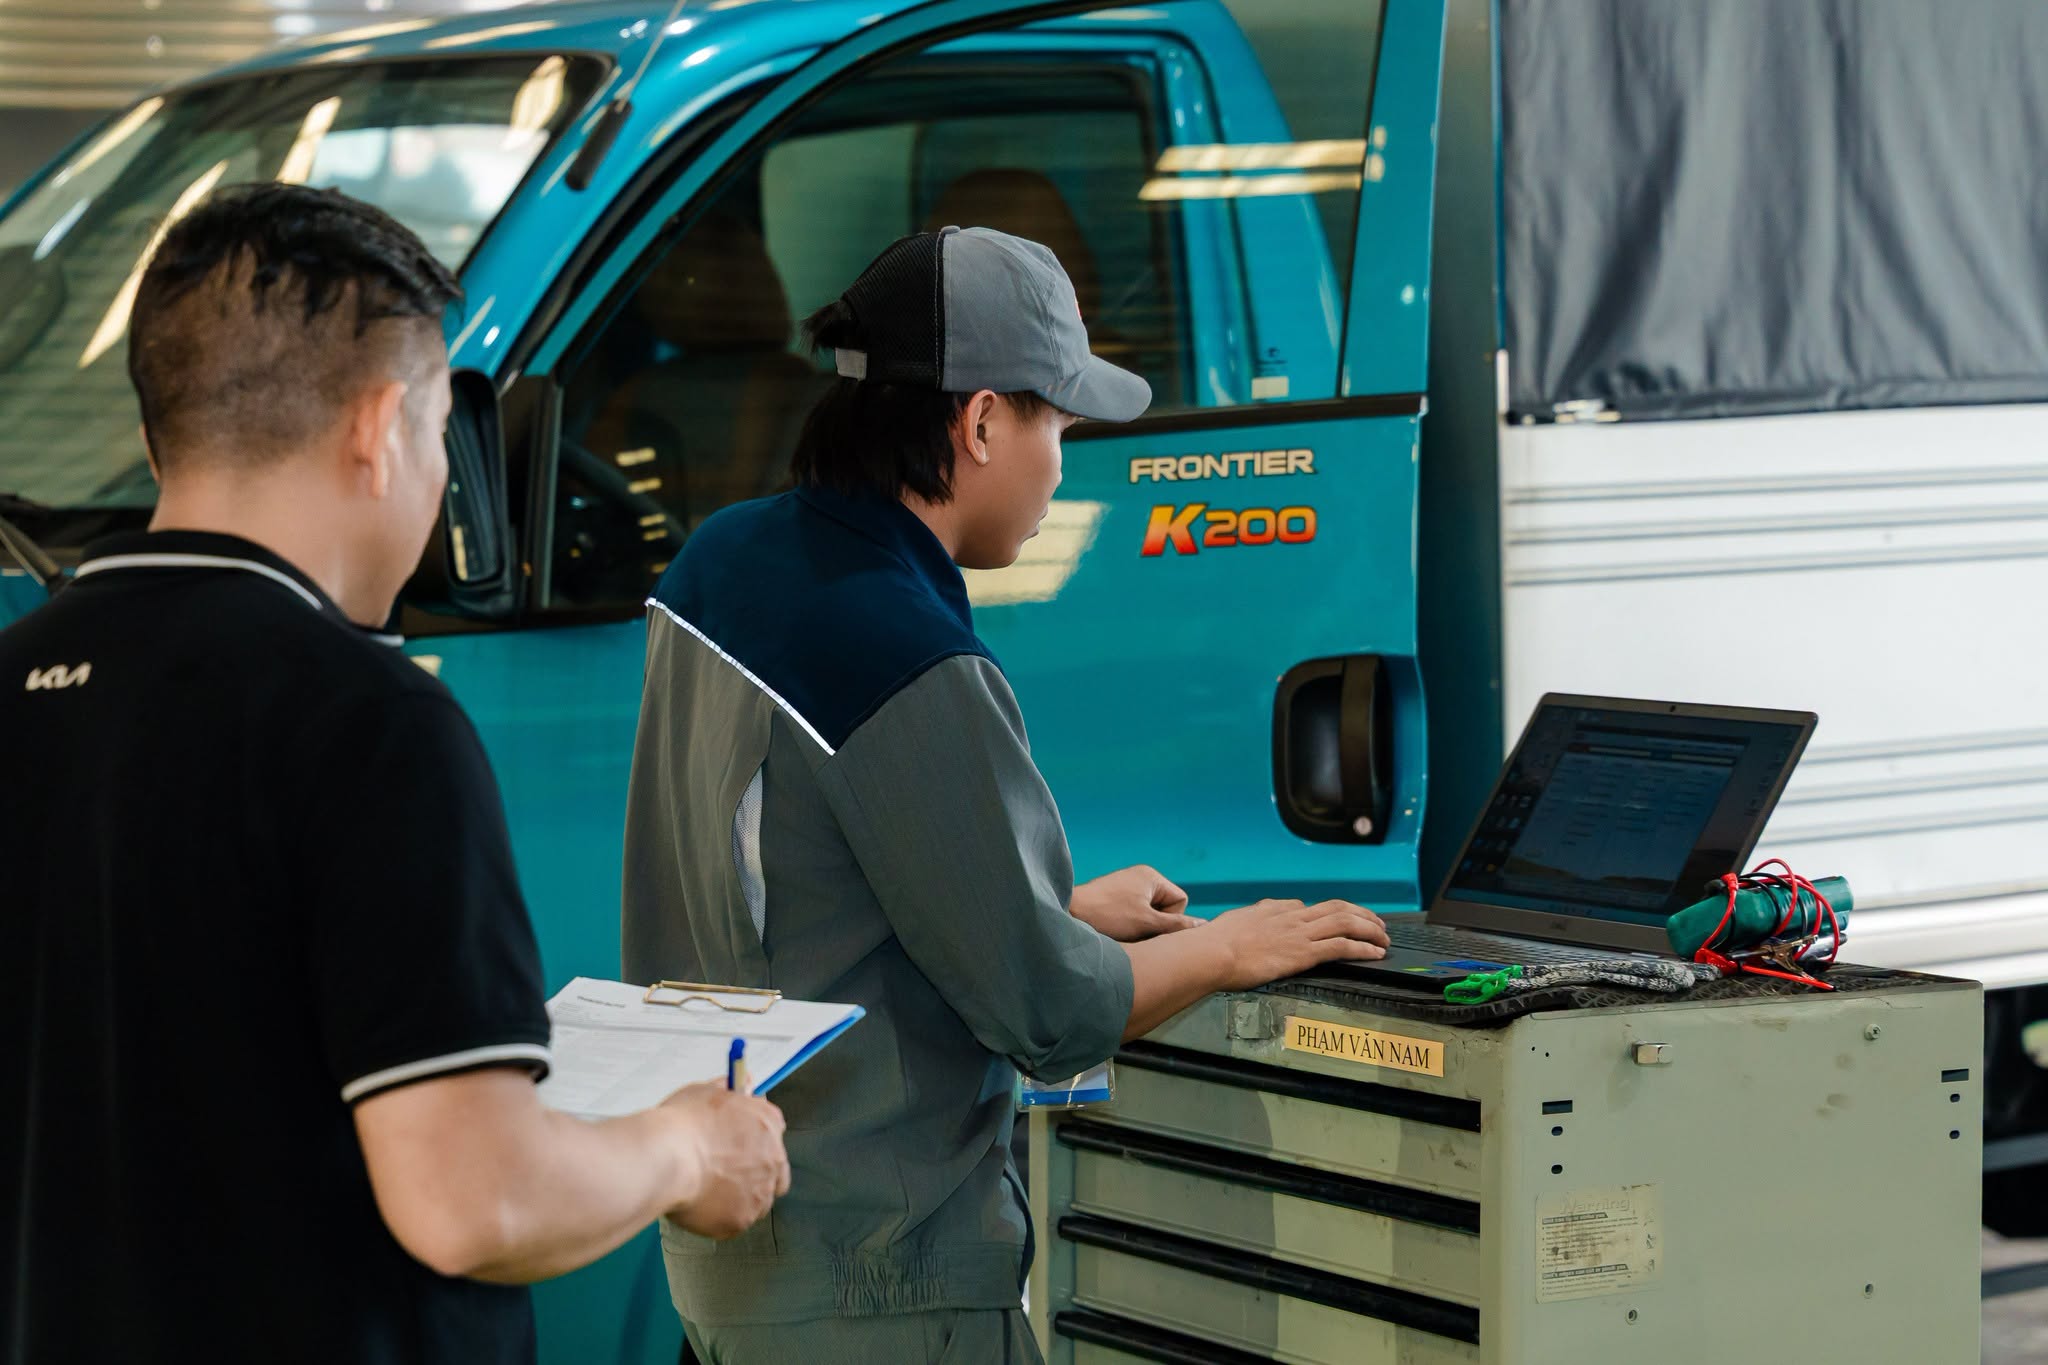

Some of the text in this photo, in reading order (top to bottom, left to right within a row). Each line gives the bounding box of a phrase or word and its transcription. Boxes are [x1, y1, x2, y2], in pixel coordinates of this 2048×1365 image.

[1128, 449, 1315, 484] FRONTIER
[1140, 502, 1318, 557] K200
[25, 662, 92, 691] KIA
[1297, 1024, 1430, 1069] PHẠM VĂN NAM
[1559, 1195, 1630, 1214] Warning
